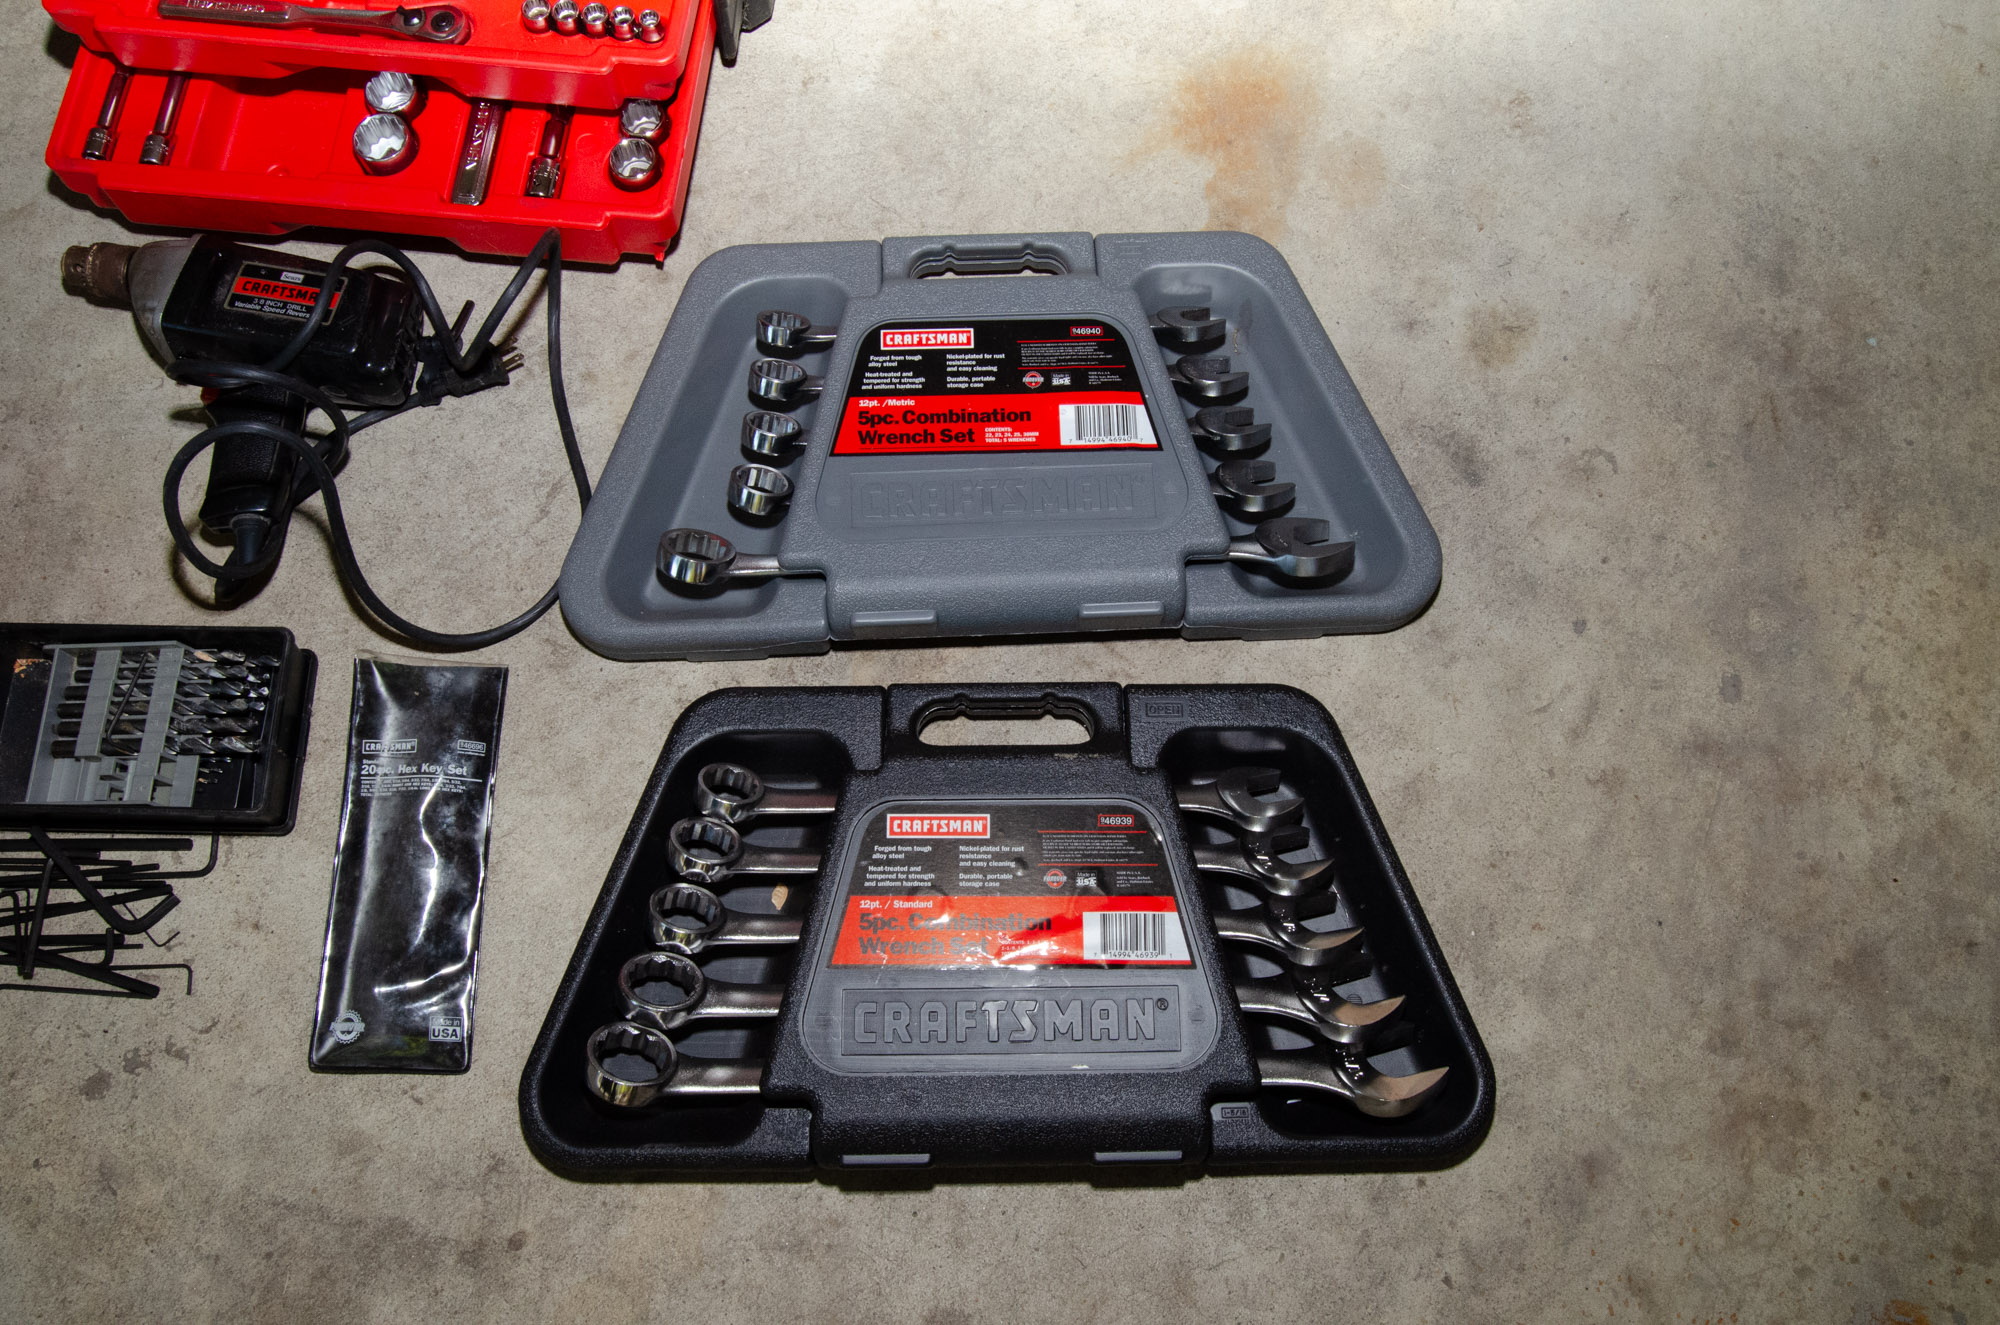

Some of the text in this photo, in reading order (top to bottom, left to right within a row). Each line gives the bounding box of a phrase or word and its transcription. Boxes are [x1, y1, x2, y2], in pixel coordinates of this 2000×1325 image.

[284, 273, 302, 281] Sears
[242, 281, 320, 302] CRAFTSMA
[234, 301, 310, 318] Variable Speed Revers
[266, 299, 283, 308] INCH
[287, 303, 307, 312] DRILL
[858, 408, 1031, 428] 5pc. Combination
[858, 428, 975, 445] Wrench Set
[398, 764, 417, 773] Hex
[421, 763, 442, 774] Key
[448, 764, 467, 775] Set
[860, 900, 882, 909] 12pt.
[893, 900, 933, 908] Standard
[859, 913, 904, 934] 5pc.
[858, 936, 988, 955] Wrench Set
[854, 999, 1156, 1042] CRAFTSMAN
[432, 1028, 458, 1038] USA
